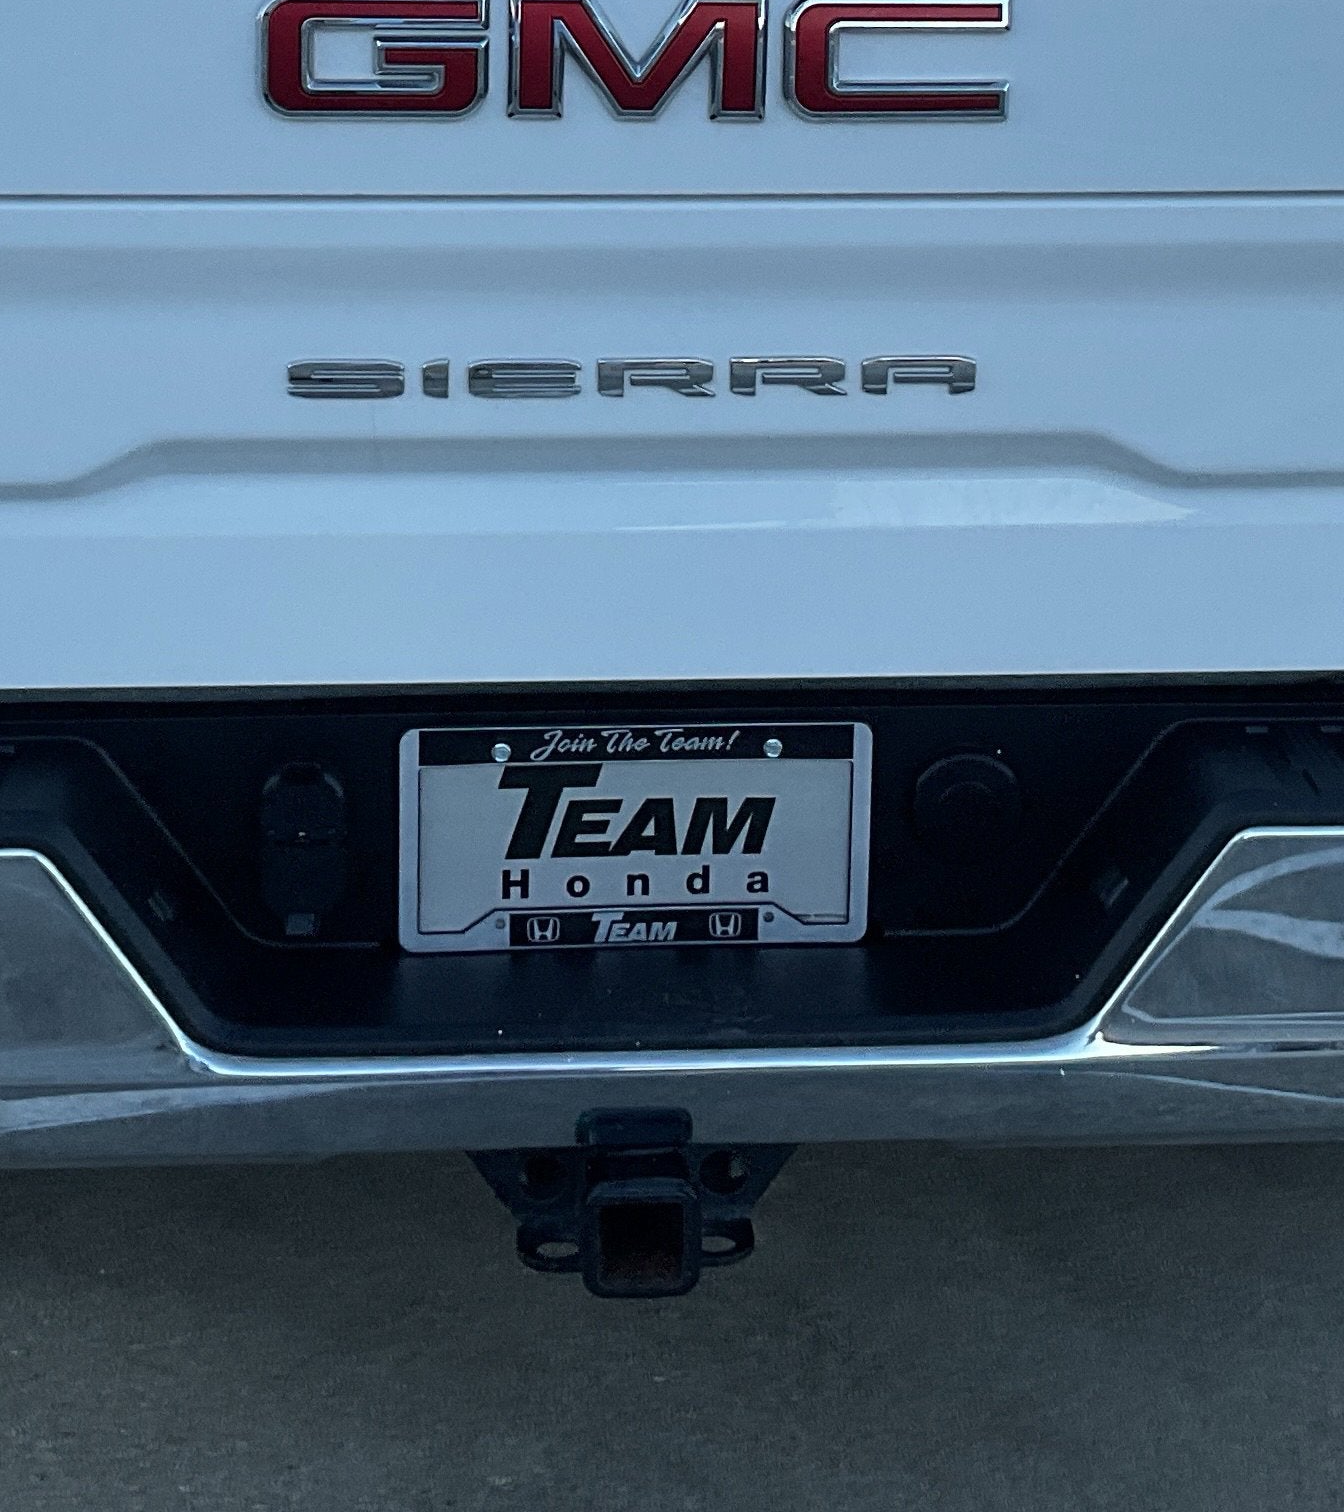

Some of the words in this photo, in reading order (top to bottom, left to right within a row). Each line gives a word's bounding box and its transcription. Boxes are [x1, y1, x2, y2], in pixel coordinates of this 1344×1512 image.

[287, 355, 977, 399] SIERRA
[530, 729, 597, 761] Join
[600, 730, 649, 753] The
[654, 729, 740, 754] Team!
[498, 763, 777, 860] TEAM
[501, 864, 770, 900] Honda
[590, 912, 678, 943] TEAM
